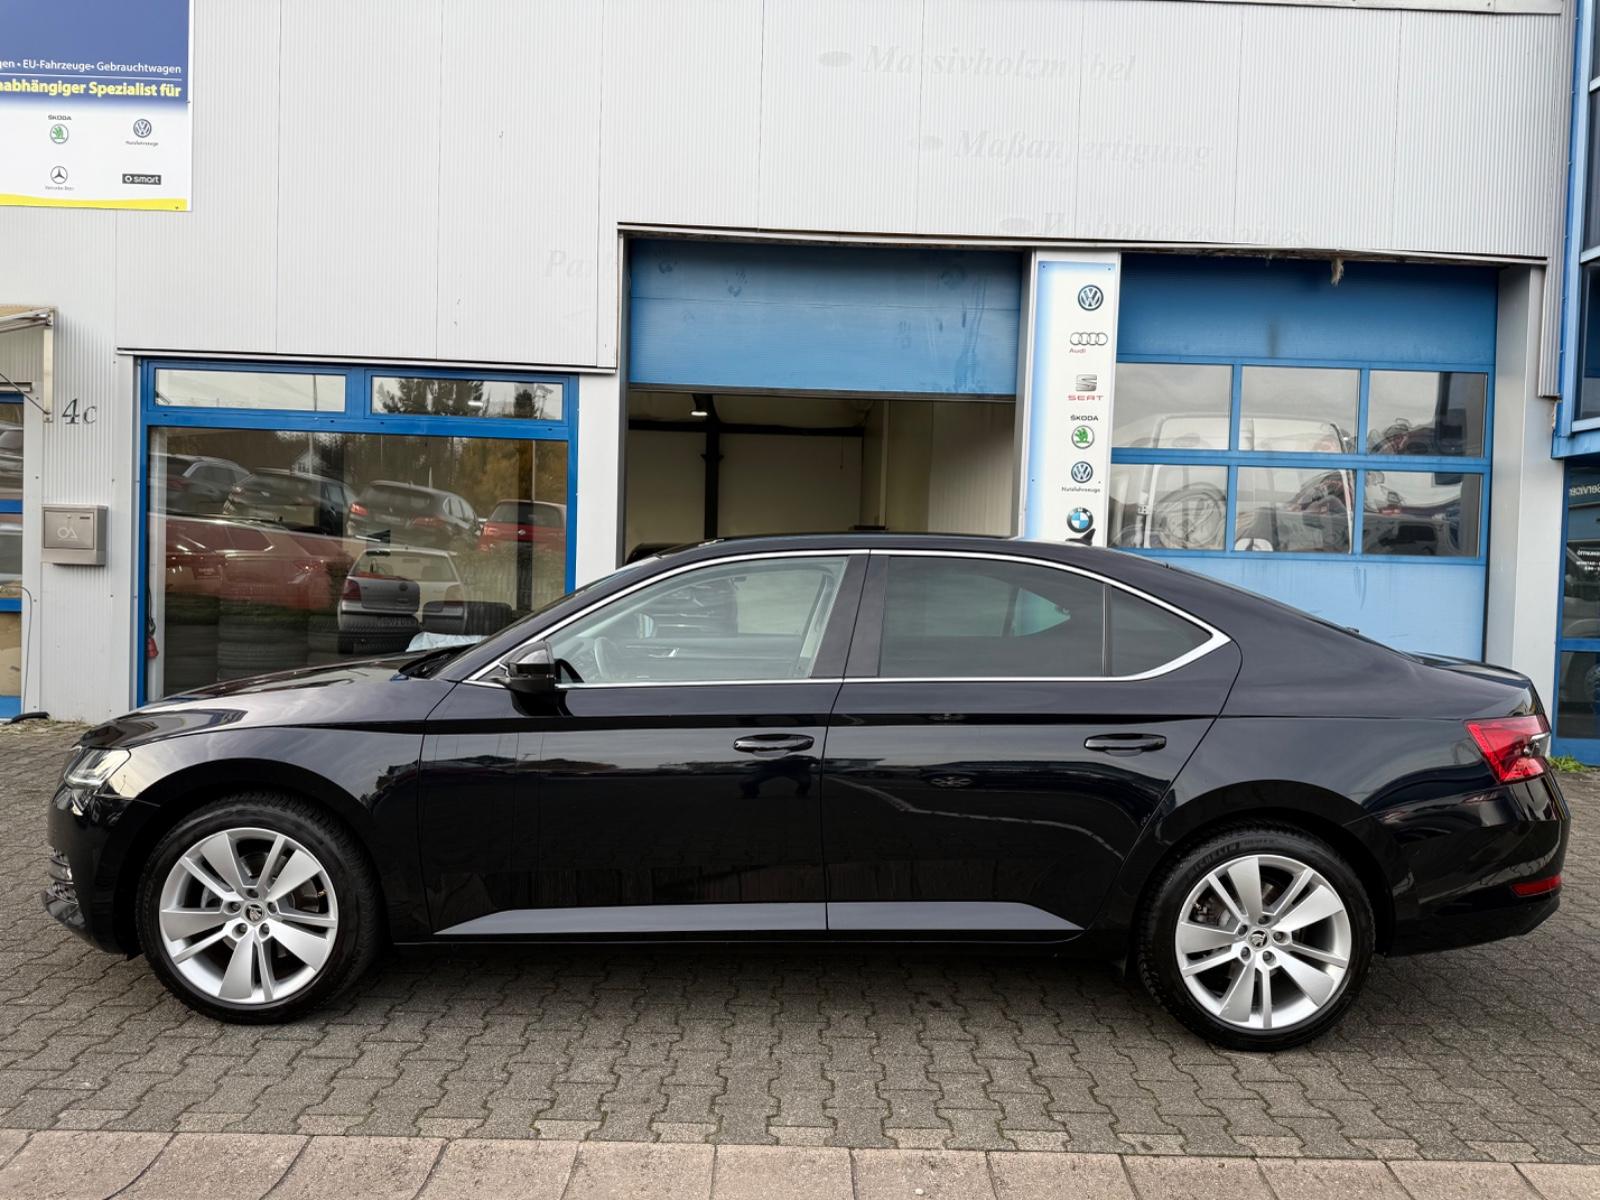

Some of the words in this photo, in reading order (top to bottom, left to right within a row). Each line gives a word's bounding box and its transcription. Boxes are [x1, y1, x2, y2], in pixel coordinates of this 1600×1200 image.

[23, 60, 91, 72] EU-Fahrzeuge
[96, 61, 181, 75] Gebrauchtwagen
[862, 45, 1136, 81] Masivholzmbel
[89, 81, 157, 98] Spezialist
[160, 83, 181, 97] für
[133, 176, 160, 184] smart
[62, 398, 97, 424] 4c
